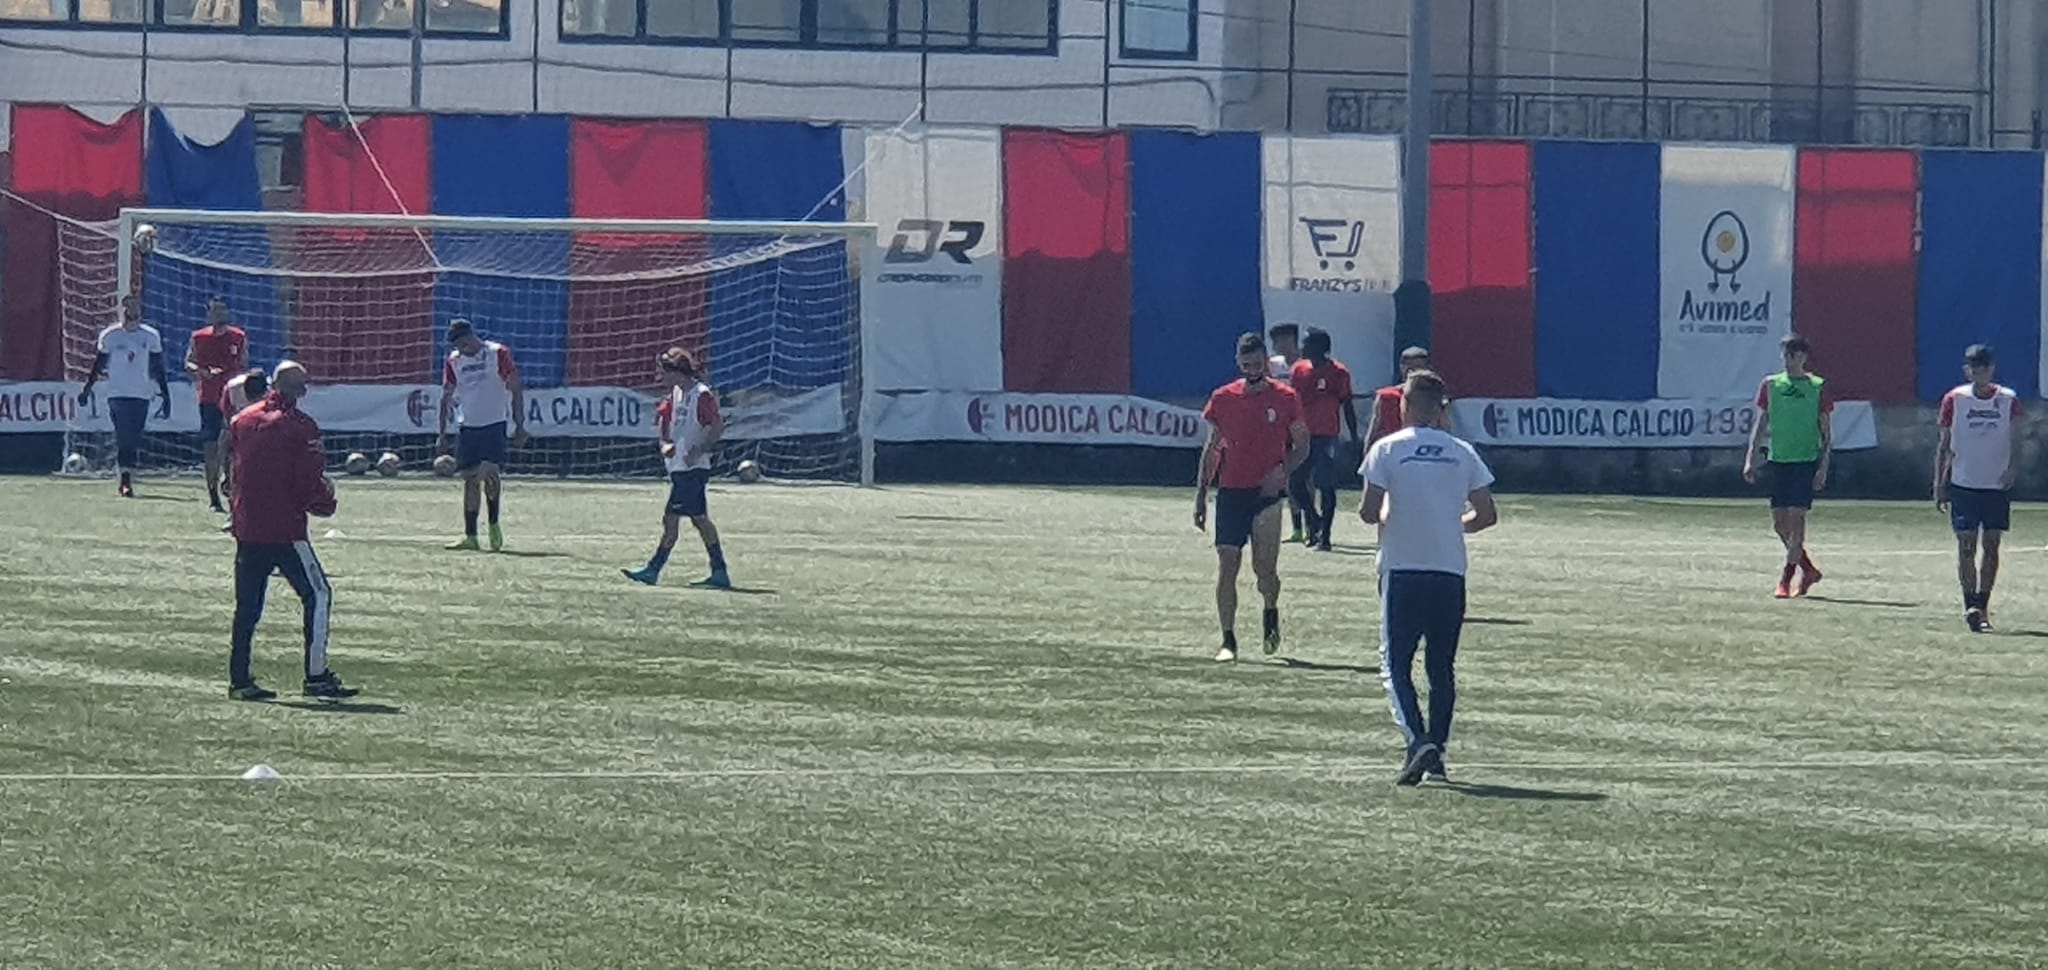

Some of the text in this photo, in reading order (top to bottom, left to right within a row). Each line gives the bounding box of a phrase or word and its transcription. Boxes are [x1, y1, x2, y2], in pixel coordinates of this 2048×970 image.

[884, 219, 985, 265] DR
[1679, 289, 1771, 322] Avimed
[551, 397, 641, 427] CALCIO
[1004, 403, 1199, 438] MODICA CALCIO
[1517, 406, 1754, 437] MODICA CALCIO 193
